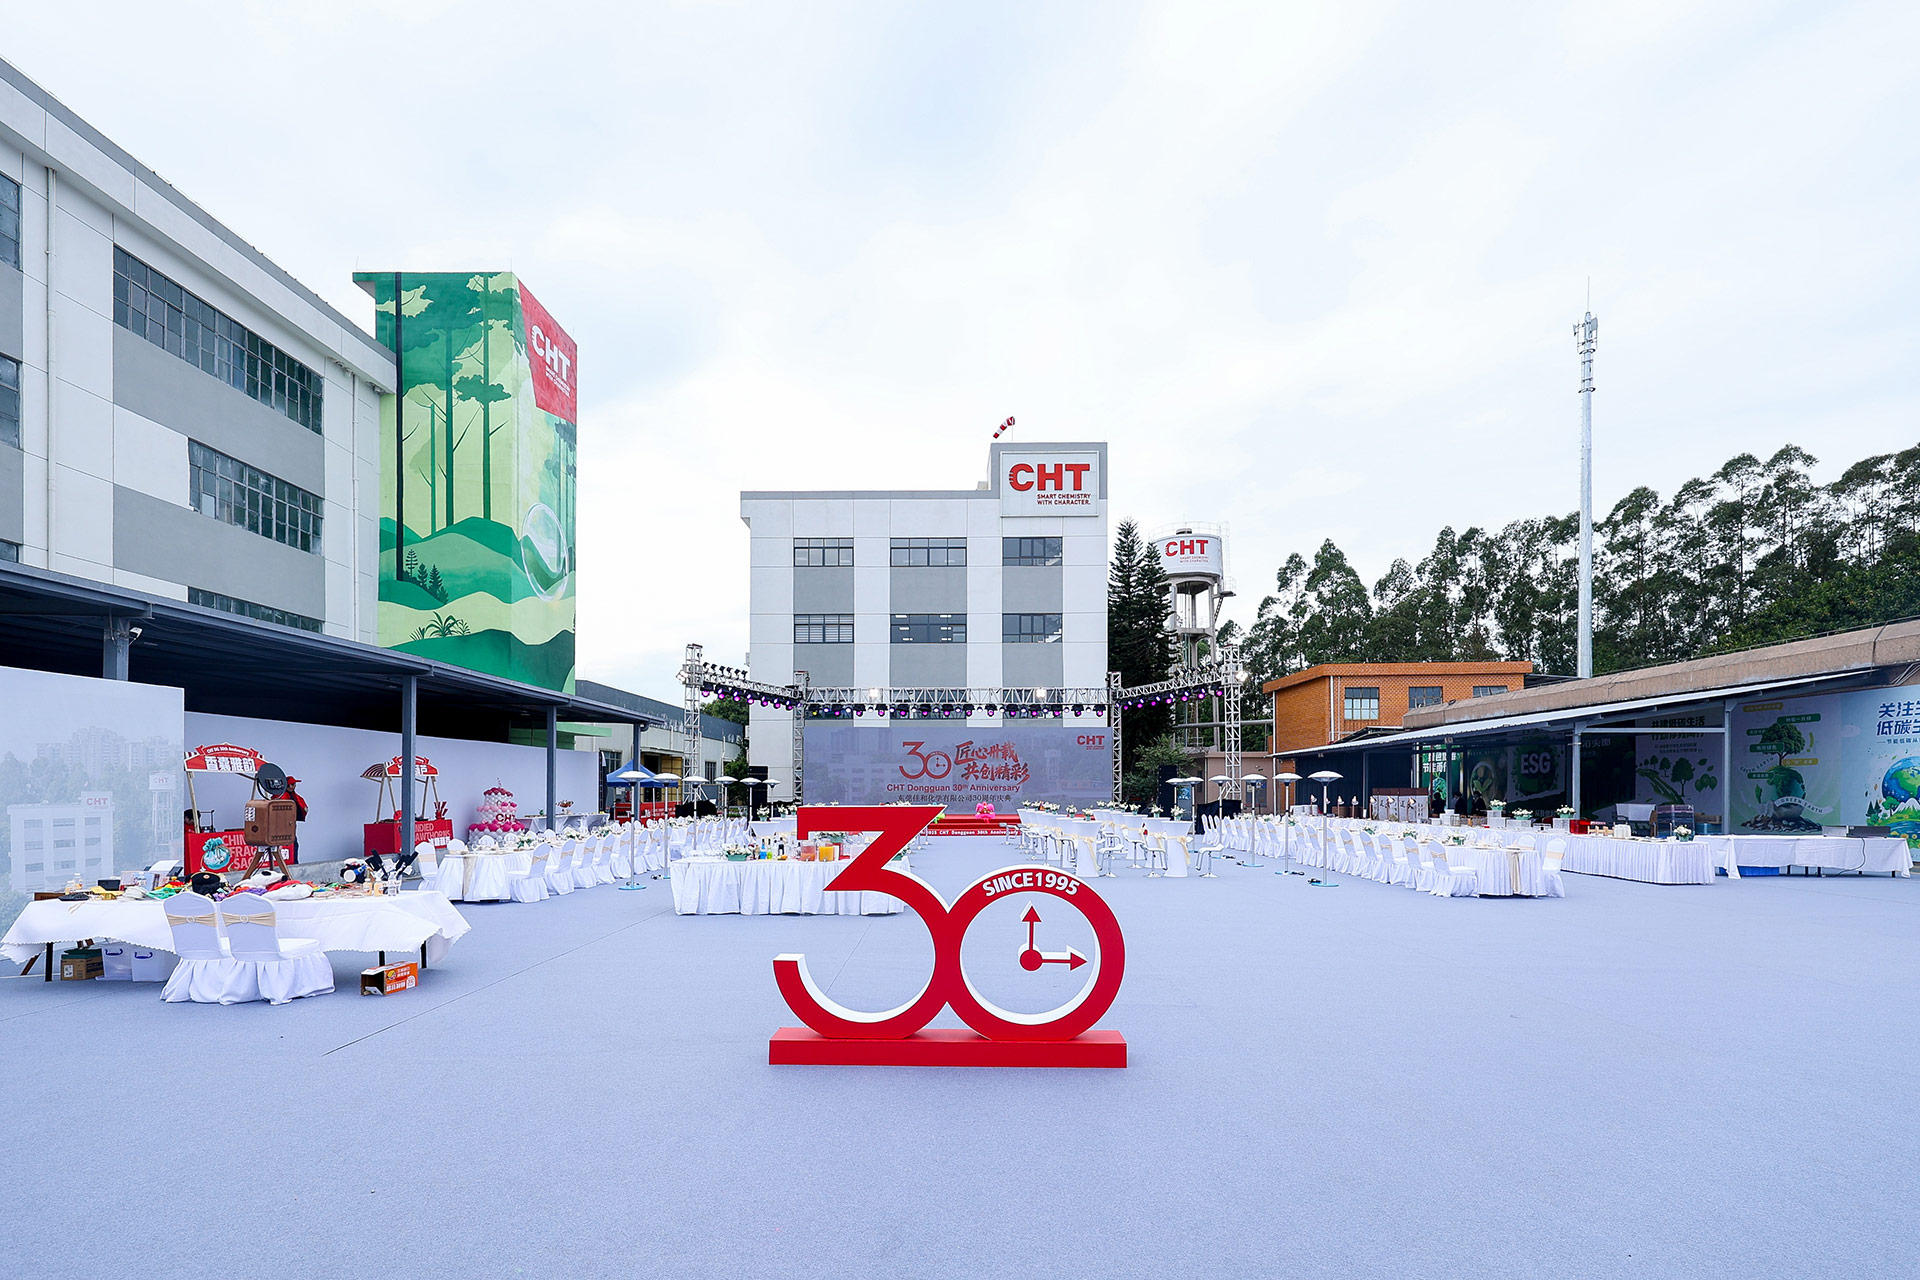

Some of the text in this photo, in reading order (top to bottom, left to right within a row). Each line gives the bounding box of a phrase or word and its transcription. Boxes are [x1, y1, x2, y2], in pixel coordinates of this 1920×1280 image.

[531, 325, 571, 381] CHT
[1008, 463, 1091, 492] CHT
[1165, 539, 1209, 557] CHT
[1076, 735, 1105, 745] CHT
[898, 741, 952, 780] 30
[1520, 751, 1551, 775] ESG
[961, 761, 1031, 785] 共创精彩
[887, 783, 905, 791] CHT
[907, 783, 950, 793] Dongguan
[970, 783, 1020, 793] Anniversary
[86, 797, 109, 806] CHT
[415, 823, 434, 832] NDIED
[222, 834, 247, 846] CHIN
[415, 830, 451, 842] AWTHORNS
[229, 845, 257, 858] FRAG
[233, 857, 253, 869] SAC
[773, 805, 1126, 1041] 30
